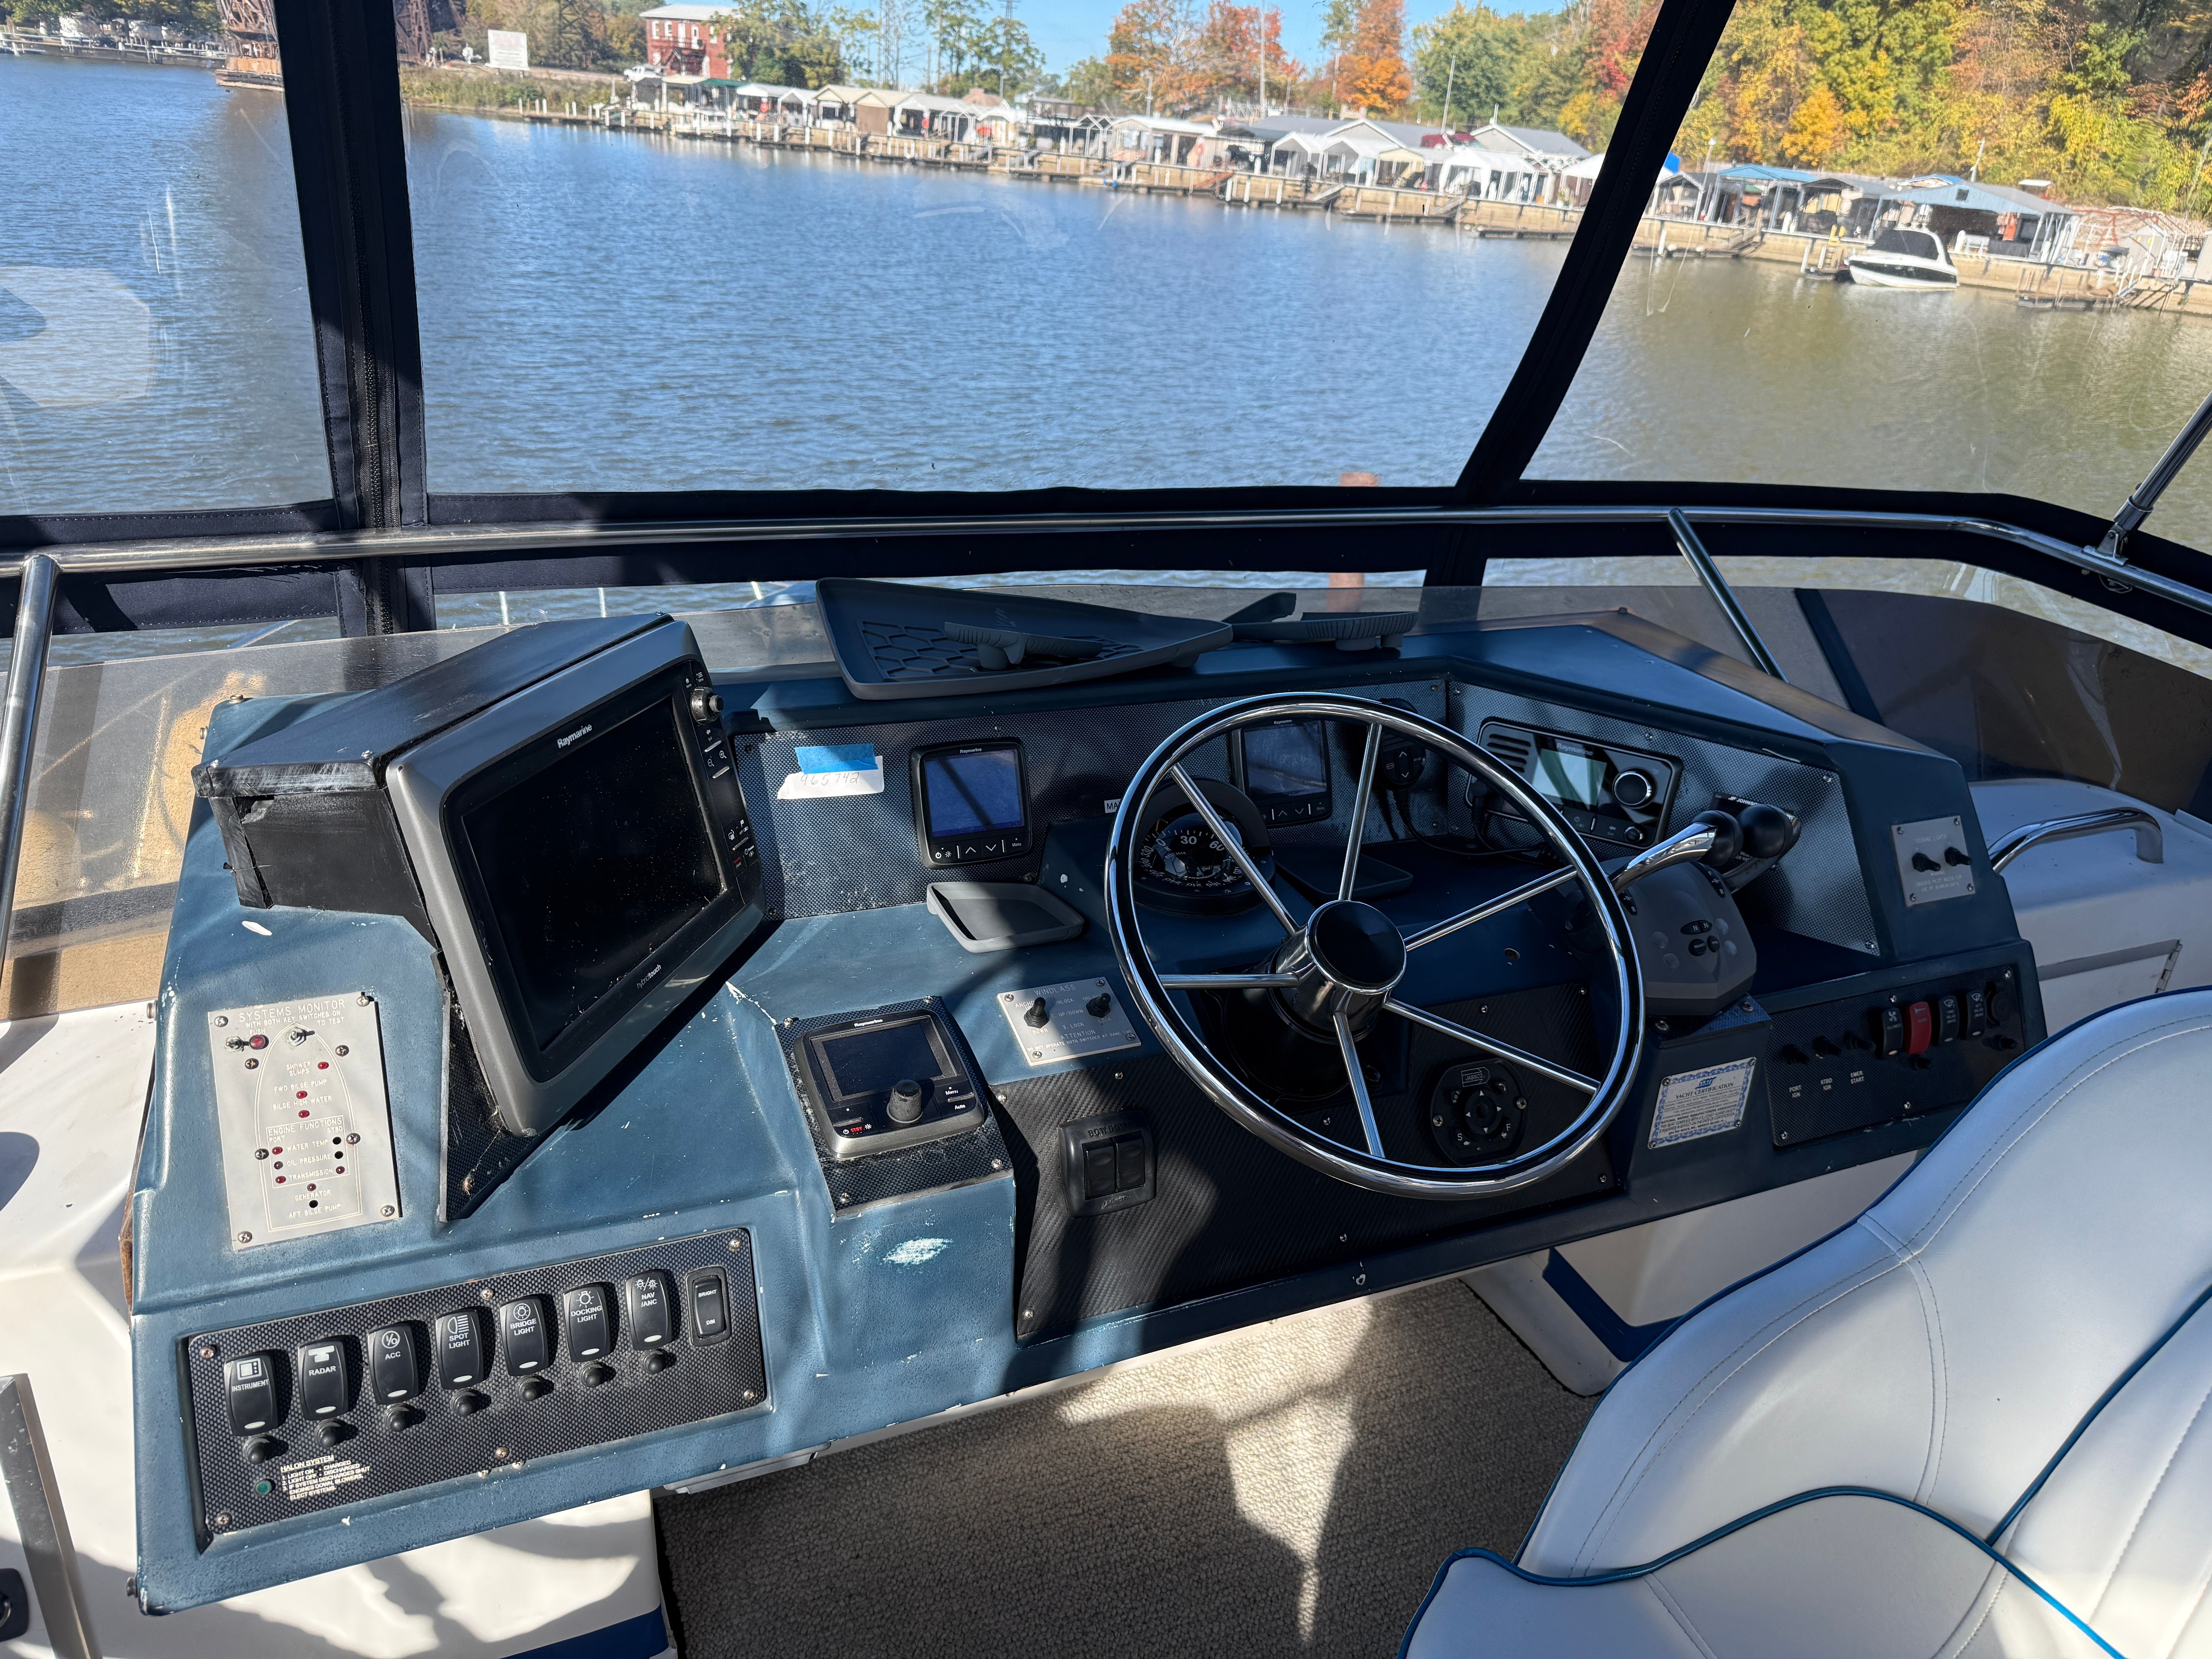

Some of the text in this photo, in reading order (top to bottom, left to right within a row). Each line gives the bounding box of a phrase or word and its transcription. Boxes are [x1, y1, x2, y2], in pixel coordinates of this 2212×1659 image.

[557, 724, 592, 749] Raymarine
[1557, 743, 1594, 756] Raymarine
[1736, 798, 1759, 806] JOHNSO
[1180, 835, 1197, 845] 30
[1209, 840, 1224, 852] 60
[1034, 984, 1076, 996] WINDLASS
[1015, 1000, 1036, 1008] ANCHO
[239, 999, 345, 1022] SYSTEMS MONITOR
[1058, 1009, 1084, 1017] UP/DOWN
[245, 1019, 261, 1028] WITH
[263, 1017, 280, 1026] BOTH
[299, 1011, 330, 1020] SWITCHES
[328, 1016, 345, 1024] TEST
[854, 1019, 883, 1027] Raymarine
[1061, 1029, 1096, 1040] ATTENTION
[286, 1061, 311, 1070] SHOWER
[289, 1068, 310, 1077] SUMPS
[1465, 1073, 1484, 1081] JABSCO
[290, 1082, 308, 1091] BILGE
[311, 1079, 327, 1088] PUMP
[1850, 1076, 1864, 1084] START
[1676, 1091, 1694, 1099] YACHT
[1695, 1082, 1734, 1095] CERTIFICATION
[1789, 1084, 1801, 1092] PORT
[273, 1095, 332, 1111] BILGE HIGH WATER
[268, 1117, 342, 1136] ENGINE FUNCTIONS
[1087, 1126, 1107, 1137] BOW
[1506, 1123, 1511, 1131] F
[269, 1126, 343, 1144] PORT STBD
[1457, 1133, 1463, 1141] S
[286, 1139, 328, 1152] WATER TEMP
[299, 1153, 332, 1165] PRESSURE
[289, 1168, 333, 1182] TRANSMISSION
[295, 1189, 331, 1201] GENERATOR
[289, 1203, 341, 1219] AFT BILGE PUMP
[641, 1291, 655, 1300] NAV
[698, 1289, 717, 1298] BRIGHT
[641, 1298, 658, 1308] /ANC
[570, 1305, 603, 1317] DOCKING
[510, 1318, 537, 1329] BRIDGE
[577, 1313, 598, 1323] LIGHT
[449, 1332, 469, 1341] SPOT
[514, 1326, 535, 1336] LIGHT
[449, 1339, 471, 1349] LIGHT
[385, 1351, 401, 1360] ACC
[309, 1365, 337, 1376] RADAR
[232, 1379, 270, 1392] INSTRUMENT
[280, 1455, 334, 1472] HALON SYSTEM
[287, 1471, 304, 1479] LIGHT
[323, 1460, 352, 1470] CHARGED
[288, 1476, 305, 1485] LIGHT
[324, 1463, 361, 1476] DISCHARGED
[295, 1478, 318, 1488] SYSTEM
[318, 1470, 355, 1483] DISCHARGES
[355, 1466, 370, 1474] SHUT
[289, 1484, 315, 1495] ENGINES
[290, 1492, 308, 1501] ELECT
